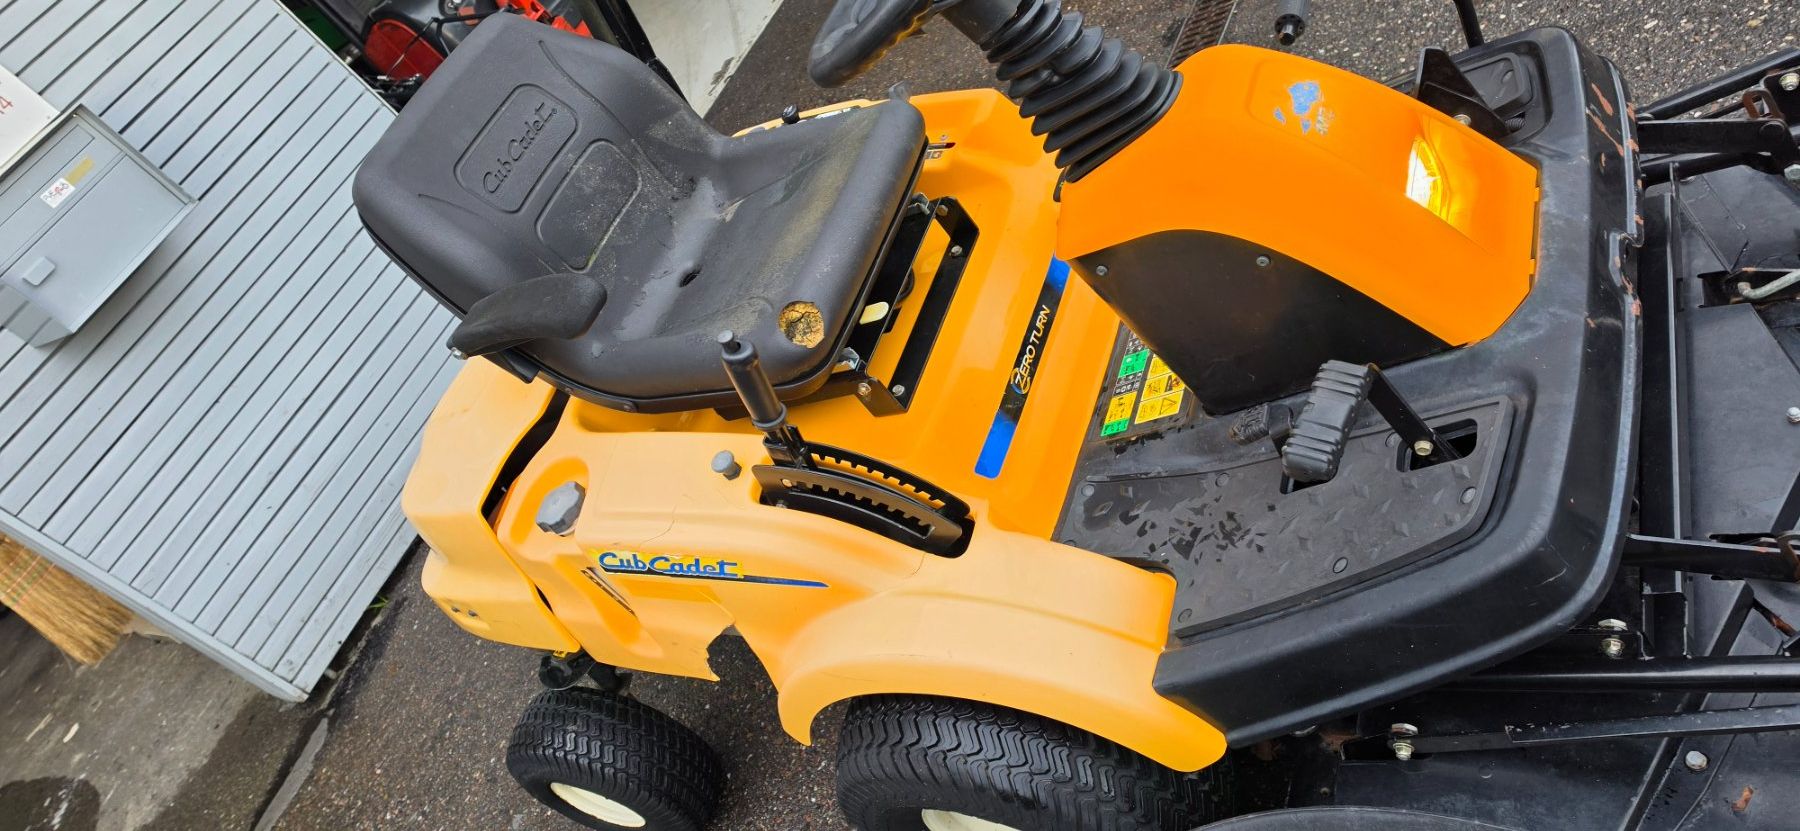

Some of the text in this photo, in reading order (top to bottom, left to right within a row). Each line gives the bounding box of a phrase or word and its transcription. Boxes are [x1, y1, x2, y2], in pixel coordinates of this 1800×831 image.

[483, 158, 513, 194] Cub
[1011, 304, 1051, 394] ZERO TURN
[599, 552, 738, 578] Cub Cadet
